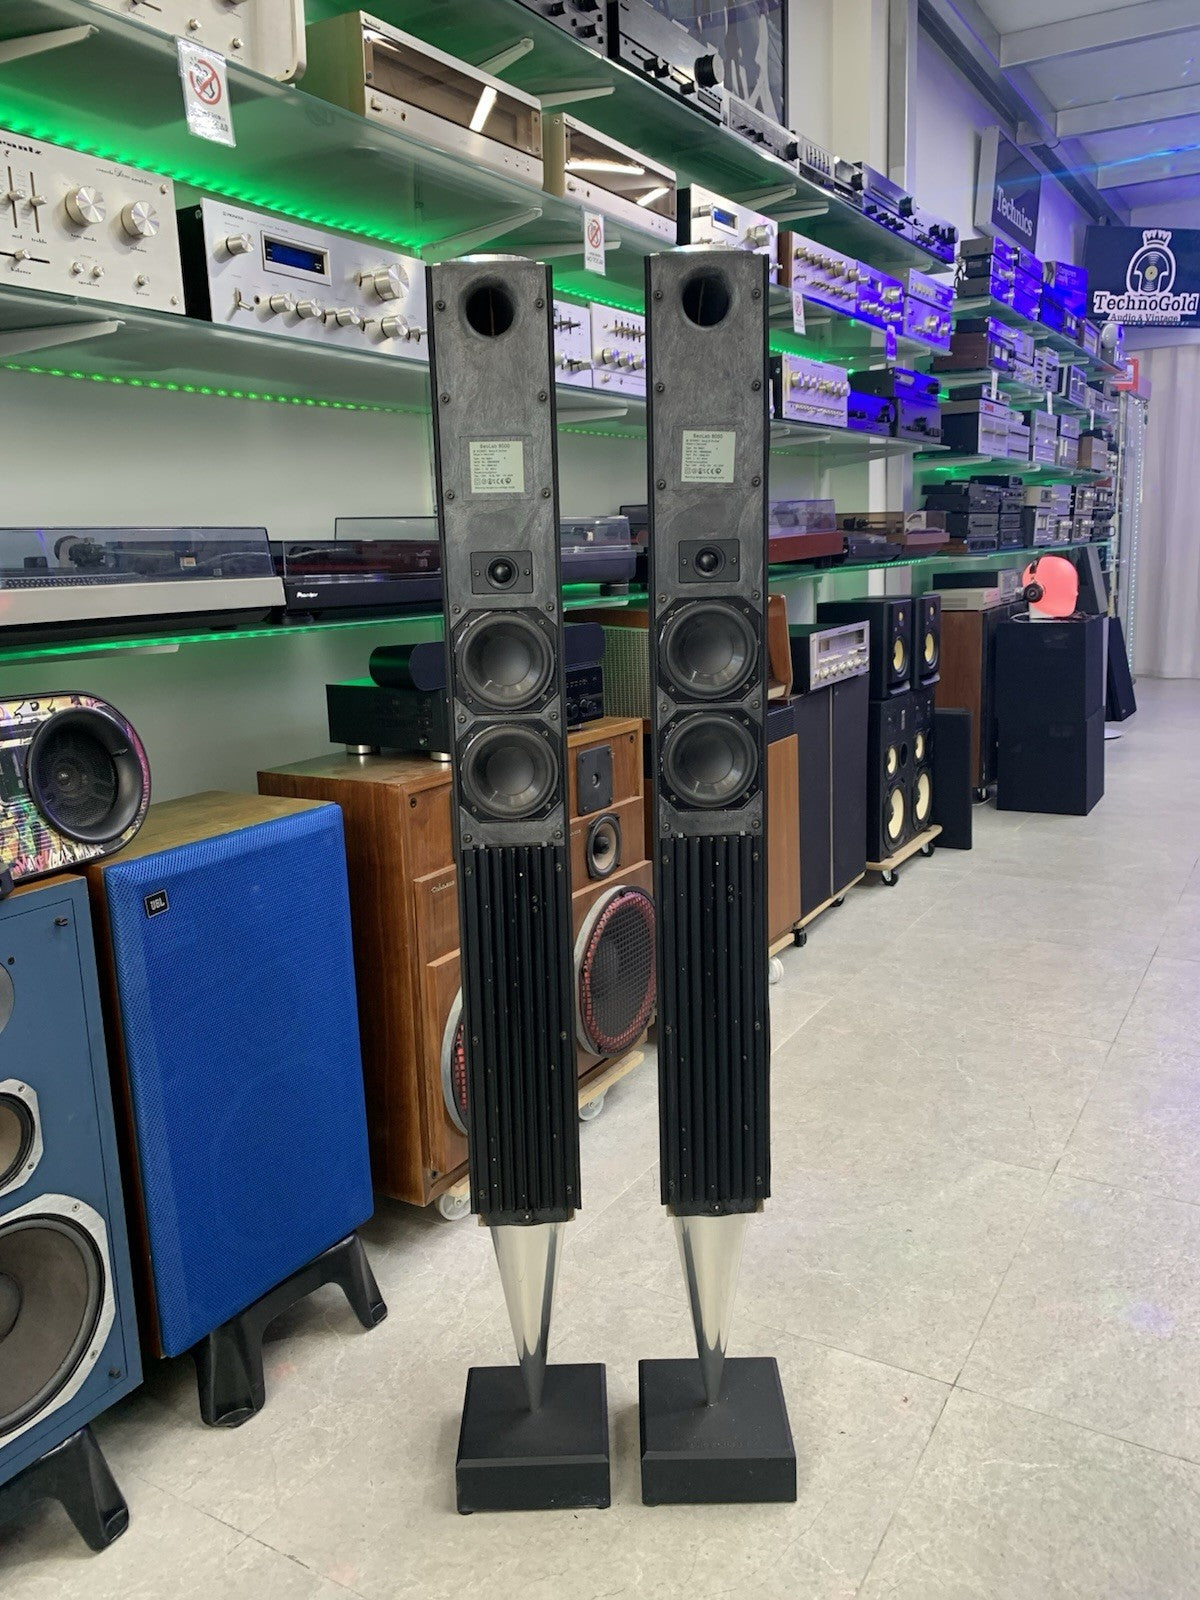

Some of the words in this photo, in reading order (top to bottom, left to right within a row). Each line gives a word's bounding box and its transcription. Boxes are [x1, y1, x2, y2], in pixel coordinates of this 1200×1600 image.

[0, 139, 42, 155] rantz
[997, 184, 1034, 238] Technics
[1094, 292, 1198, 314] TechnoGold
[1110, 313, 1136, 322] Audio
[1145, 313, 1179, 322] Vintage
[150, 897, 165, 910] JBL
